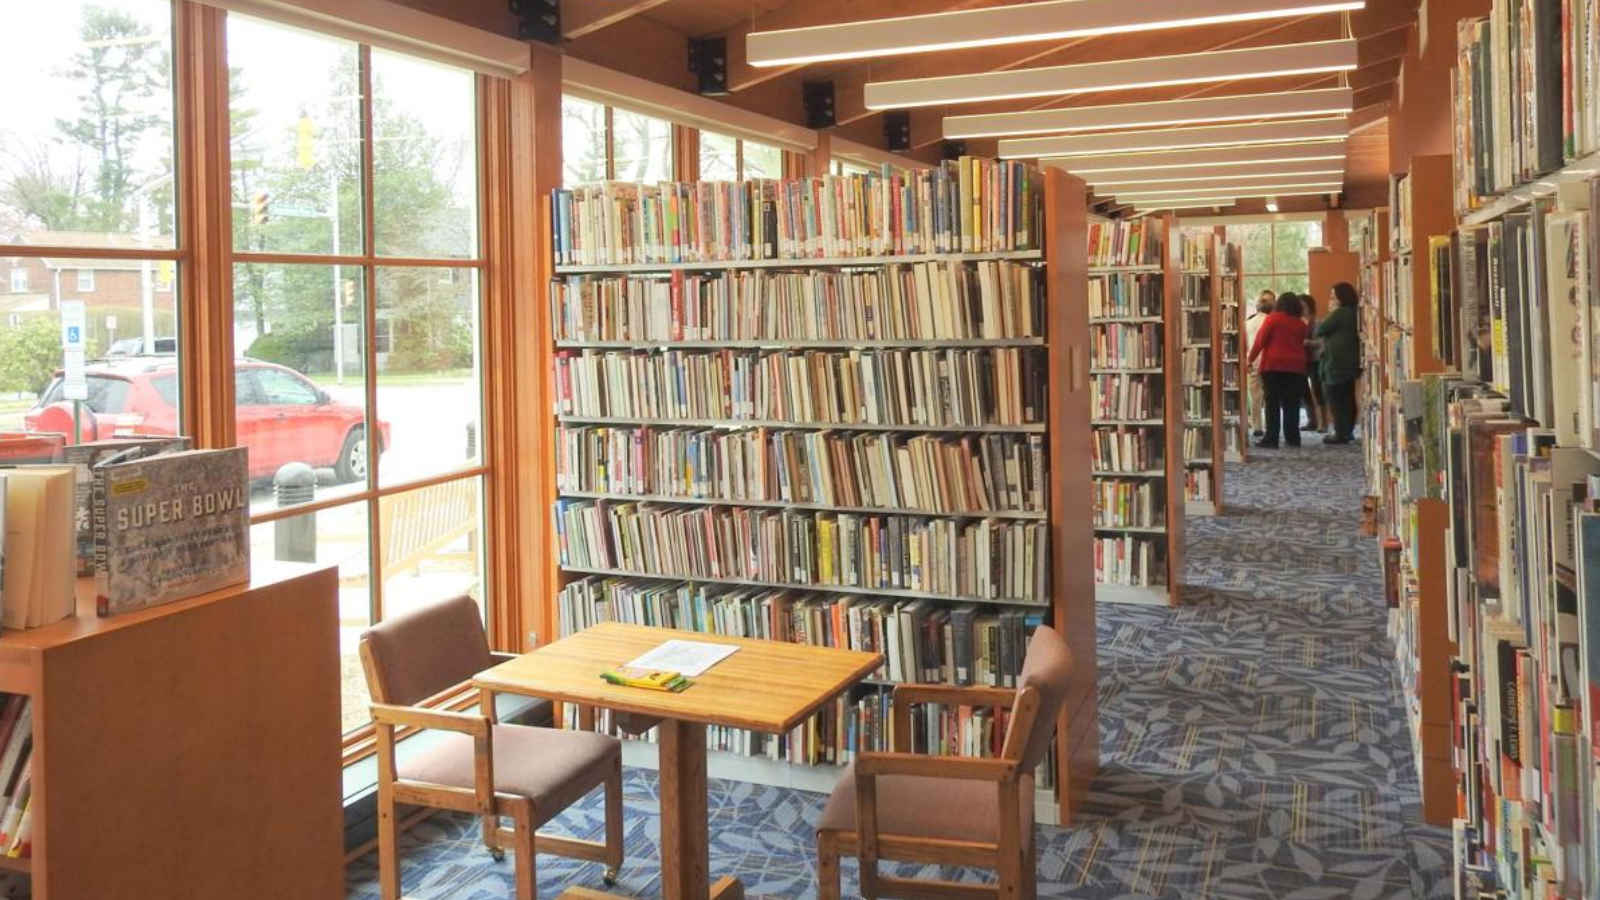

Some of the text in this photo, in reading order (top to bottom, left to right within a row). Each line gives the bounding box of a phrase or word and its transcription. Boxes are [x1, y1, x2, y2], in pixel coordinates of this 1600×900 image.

[174, 481, 197, 493] THE
[95, 499, 105, 538] SUPER
[117, 487, 244, 531] SUPER BOWL
